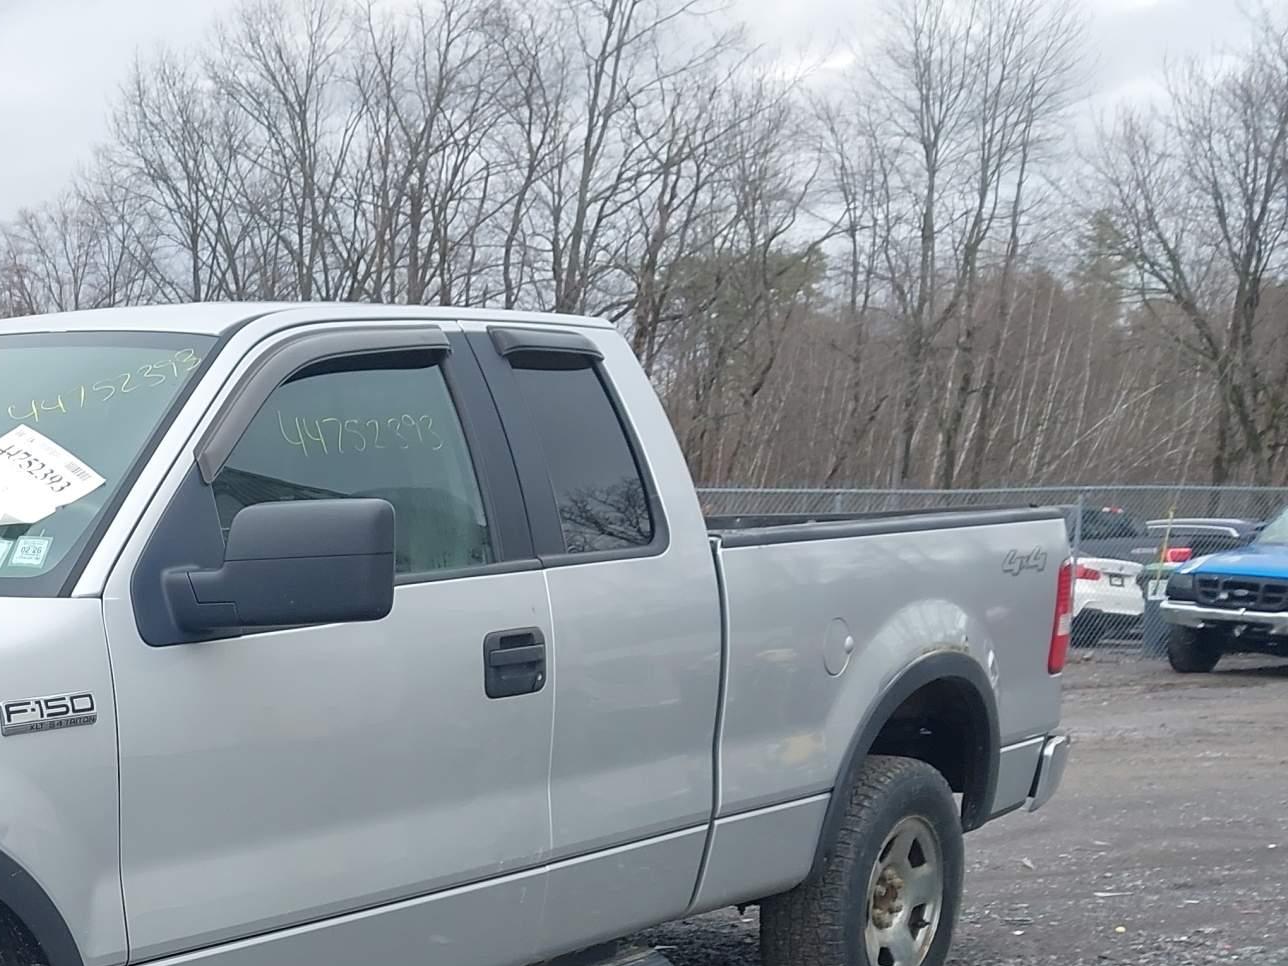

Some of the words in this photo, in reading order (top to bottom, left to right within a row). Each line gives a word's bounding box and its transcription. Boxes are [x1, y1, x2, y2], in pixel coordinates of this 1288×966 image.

[277, 410, 444, 456] 44752393
[1001, 545, 1048, 577] 4x4
[4, 693, 95, 722] F-150
